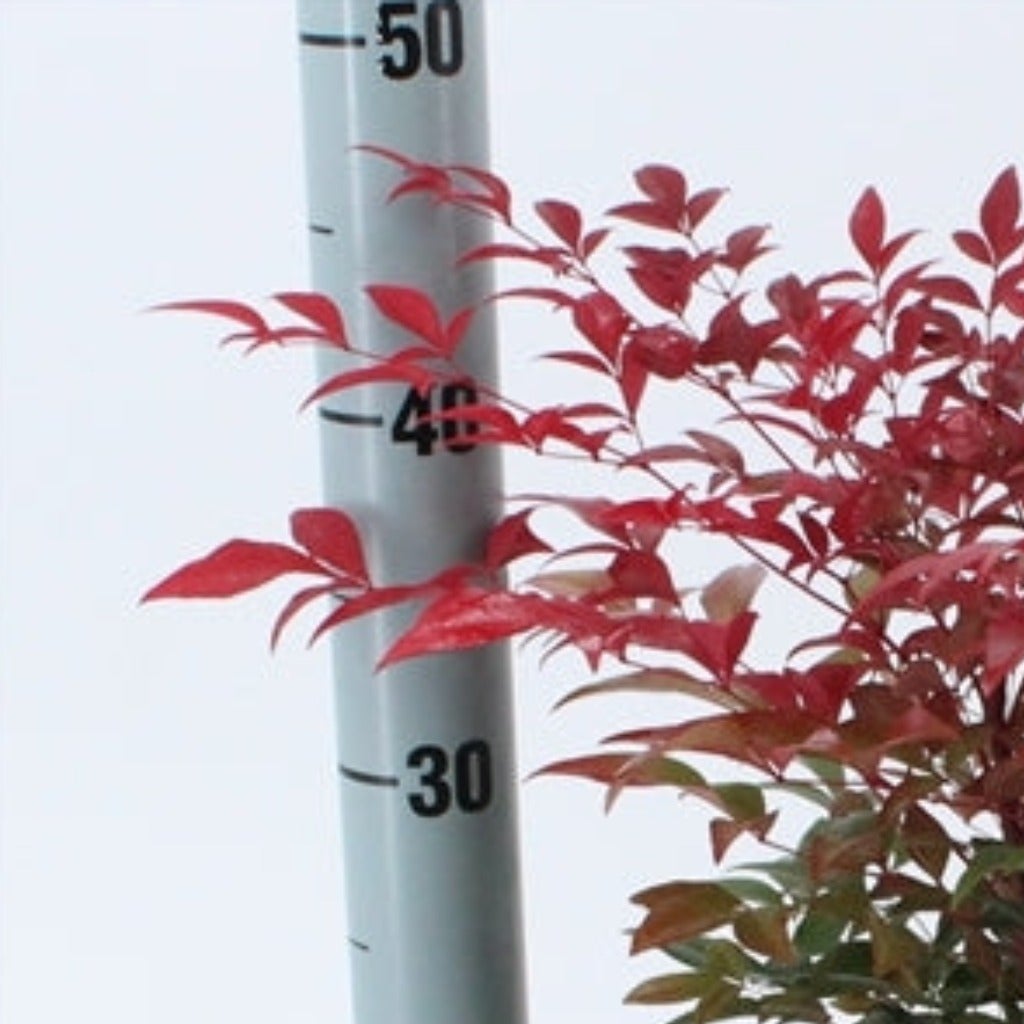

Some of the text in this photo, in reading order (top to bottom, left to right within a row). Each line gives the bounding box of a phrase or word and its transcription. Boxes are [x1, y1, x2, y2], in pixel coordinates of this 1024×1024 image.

[376, 0, 463, 80] 50
[392, 377, 479, 456] 40
[406, 739, 493, 818] 30
